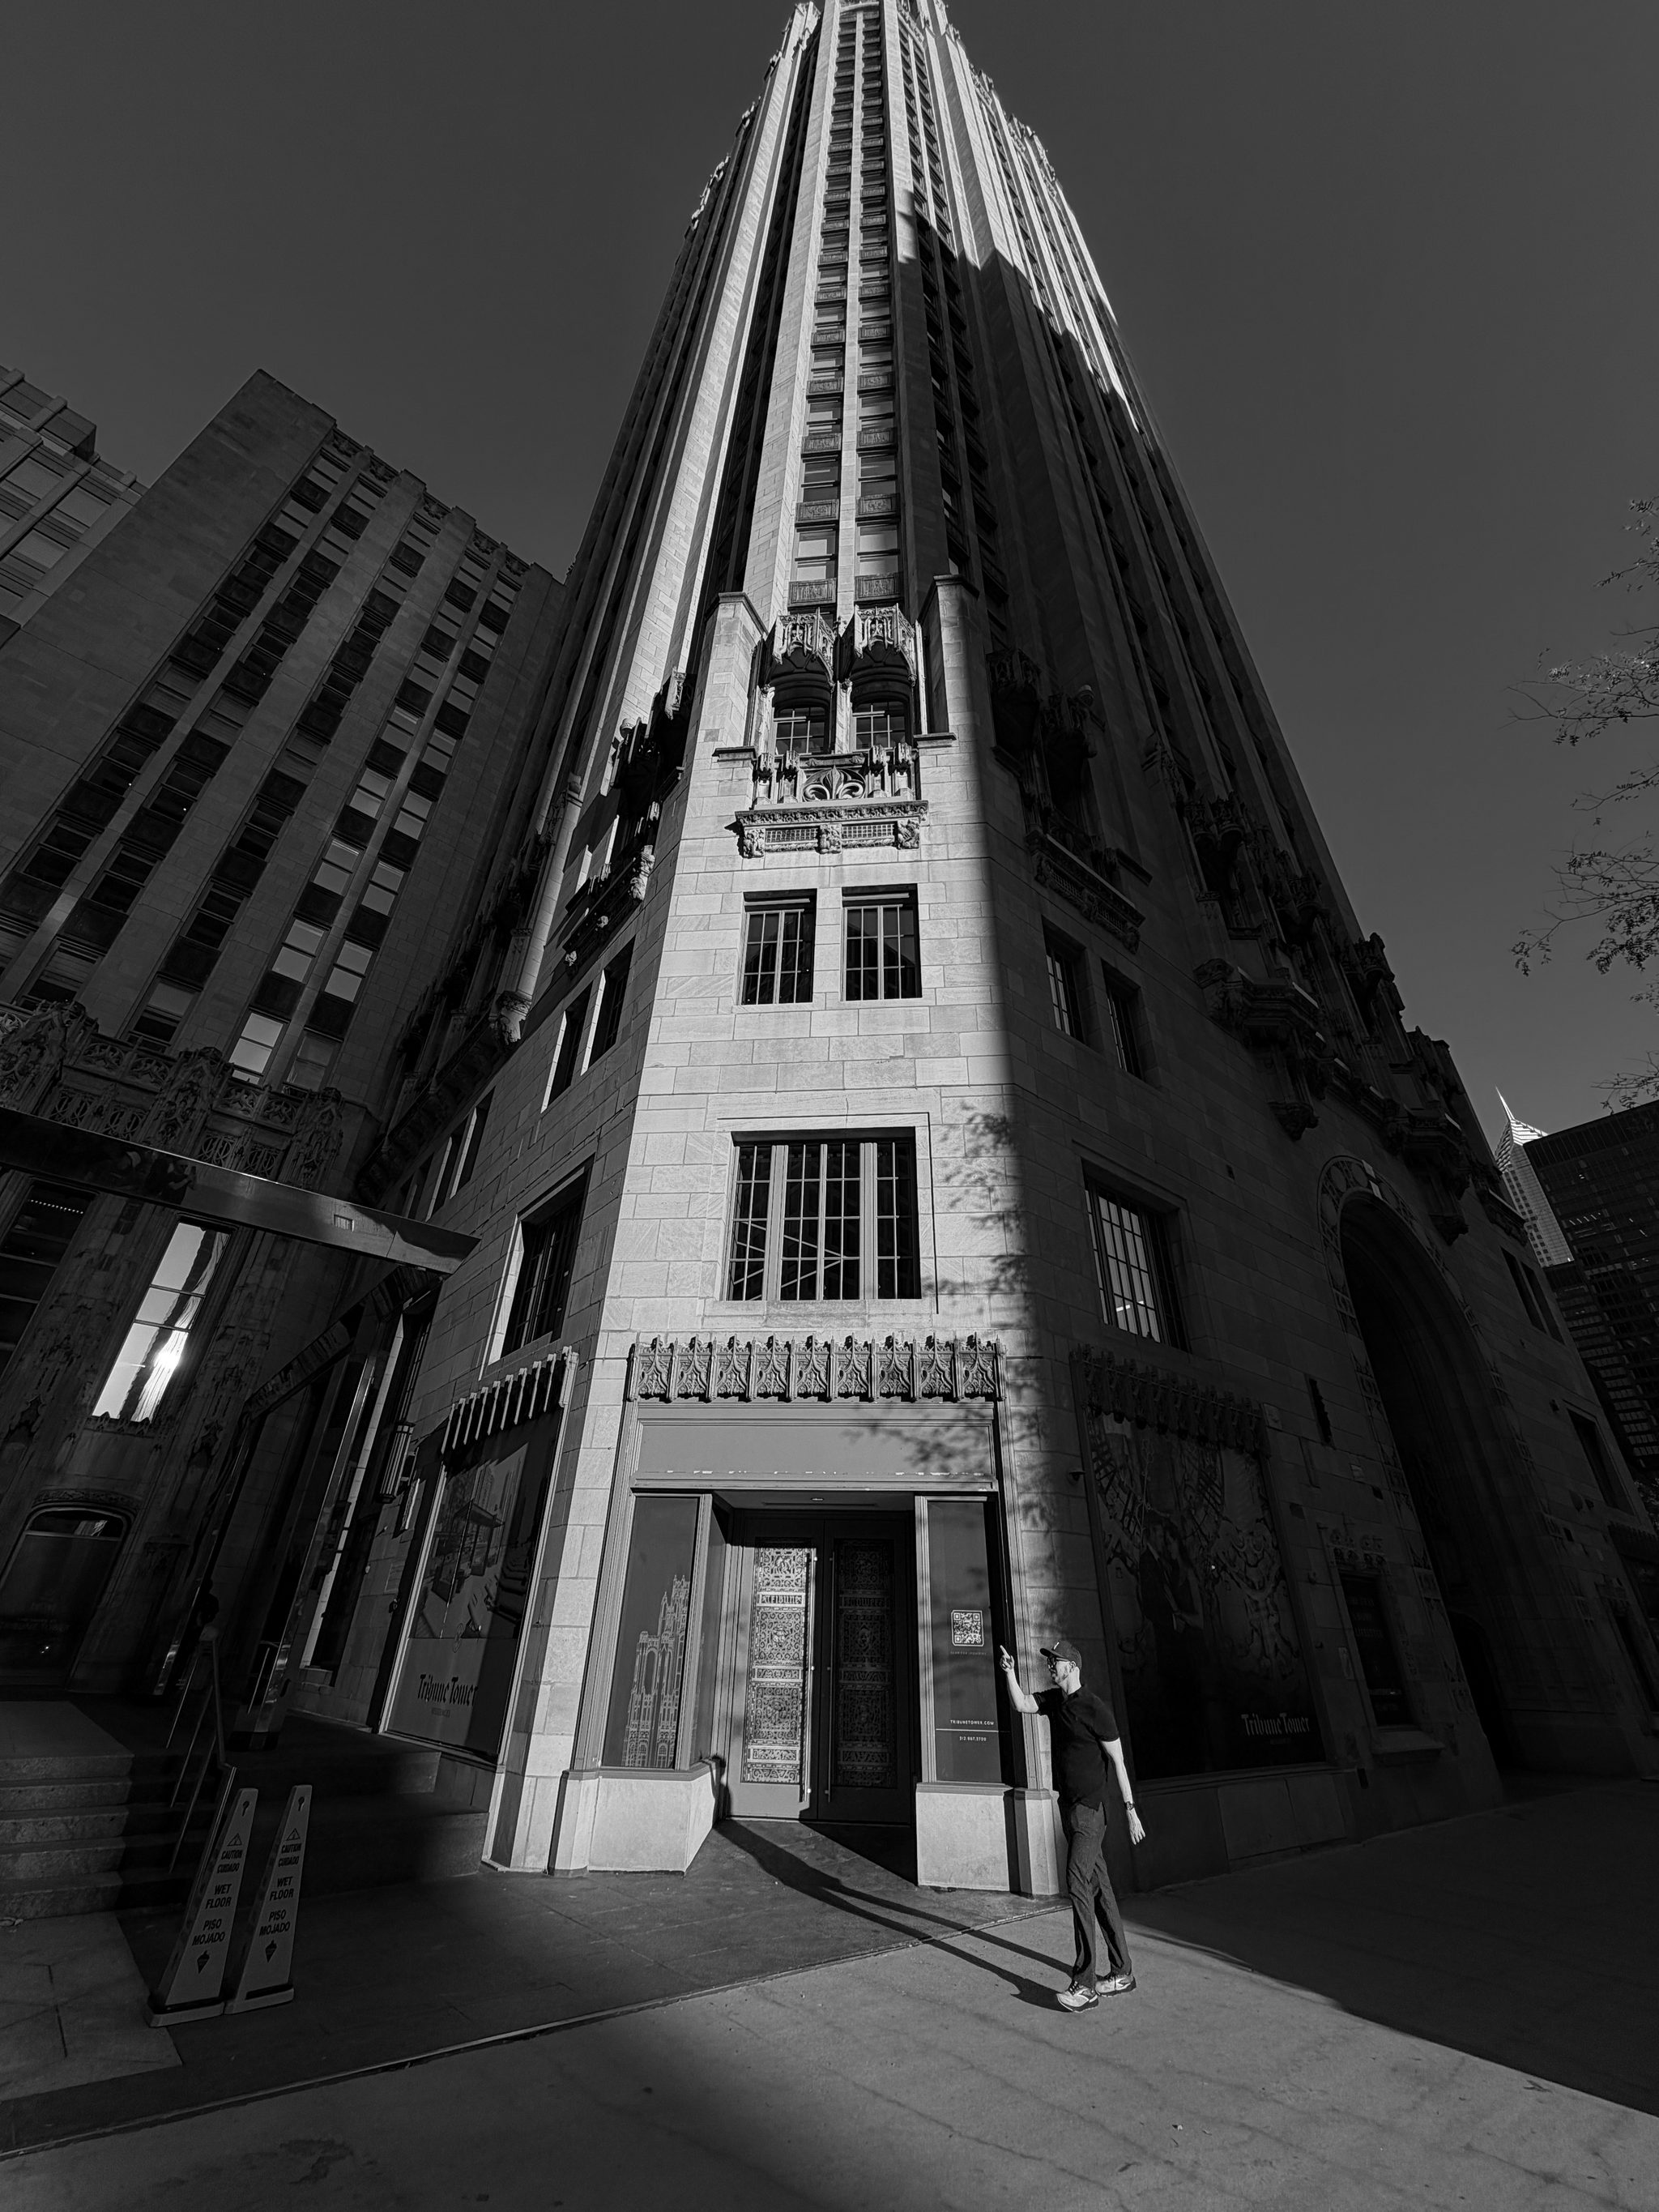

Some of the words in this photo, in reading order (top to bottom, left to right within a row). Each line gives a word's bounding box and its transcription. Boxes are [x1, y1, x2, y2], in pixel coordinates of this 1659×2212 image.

[417, 1674, 450, 1703] Tribune
[449, 1677, 479, 1706] Tower
[1240, 1712, 1283, 1736] Tribune
[1279, 1711, 1310, 1735] Tower
[277, 1876, 293, 1887] WET
[214, 1884, 232, 1895] WET
[269, 1888, 294, 1901] FLOOR
[205, 1897, 232, 1909] FLOOR
[268, 1909, 286, 1922] PISO
[203, 1919, 222, 1931] PISO
[259, 1921, 291, 1937] MOJADO
[192, 1932, 225, 1946] MOJADO
